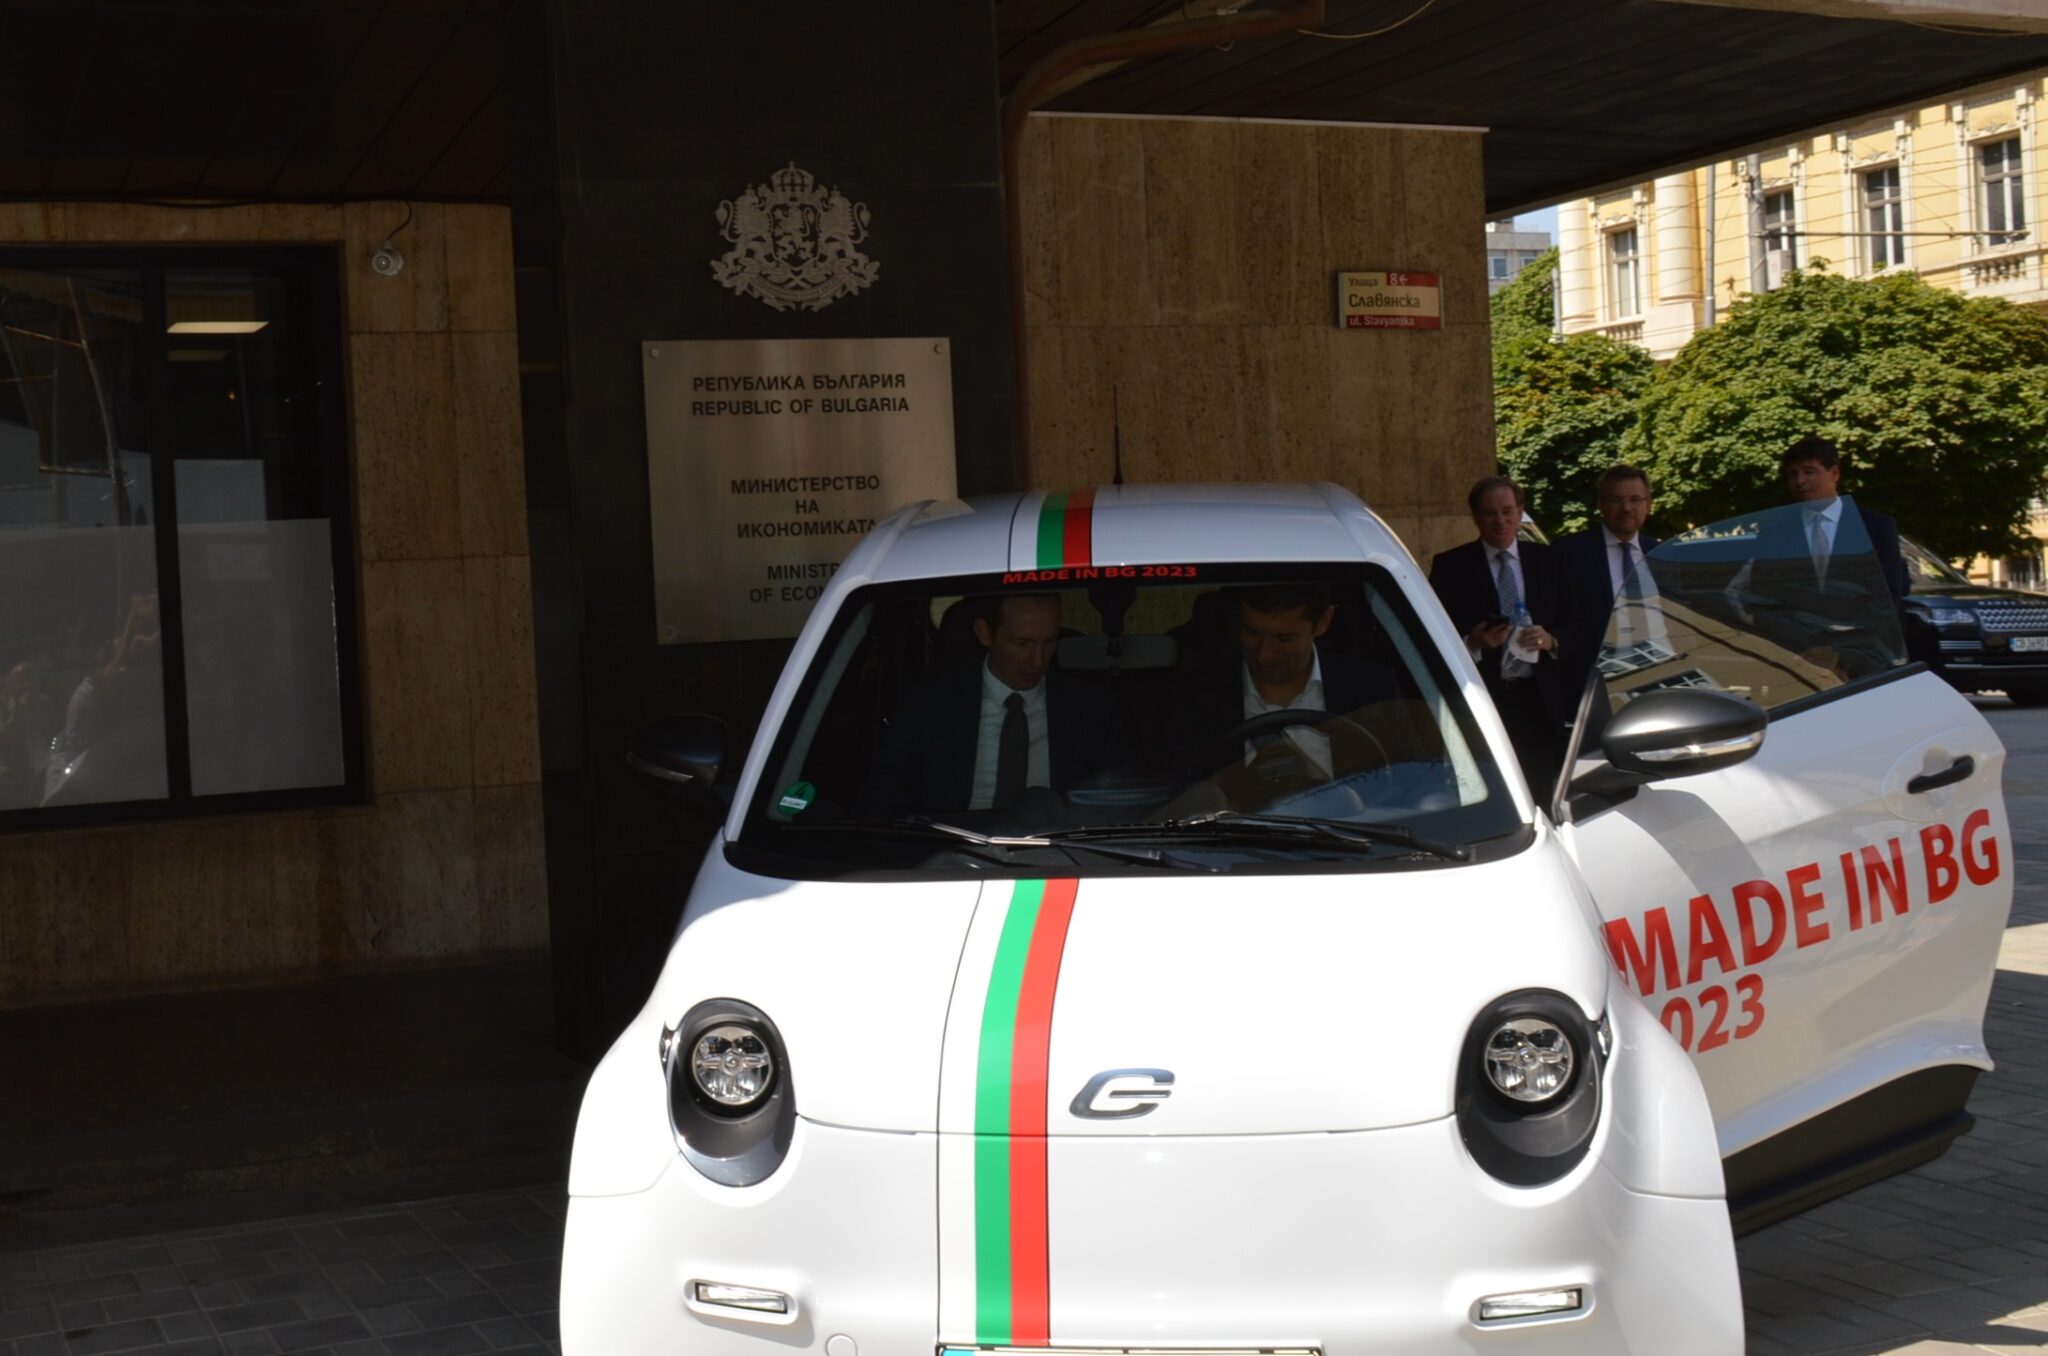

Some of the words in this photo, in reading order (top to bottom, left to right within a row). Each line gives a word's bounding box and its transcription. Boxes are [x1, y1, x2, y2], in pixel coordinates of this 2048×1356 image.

[1349, 292, 1421, 309] Славянска
[692, 375, 806, 392] РЕПУБЛИКА
[812, 373, 906, 390] БЪЛГАРИЯ
[691, 399, 782, 417] REPUBLIC
[789, 398, 814, 414] OF
[821, 397, 910, 414] BULGARIA
[730, 474, 880, 495] МИНИСТЕРСТВО
[795, 499, 820, 514] НА
[1002, 569, 1070, 585] MADE
[1075, 568, 1099, 580] IN
[1104, 566, 1137, 578] BG
[1141, 566, 1198, 578] 2023
[749, 587, 773, 604] OF
[1601, 862, 1830, 998] MADE
[1839, 836, 1910, 932] IN
[1919, 808, 2001, 905] BG
